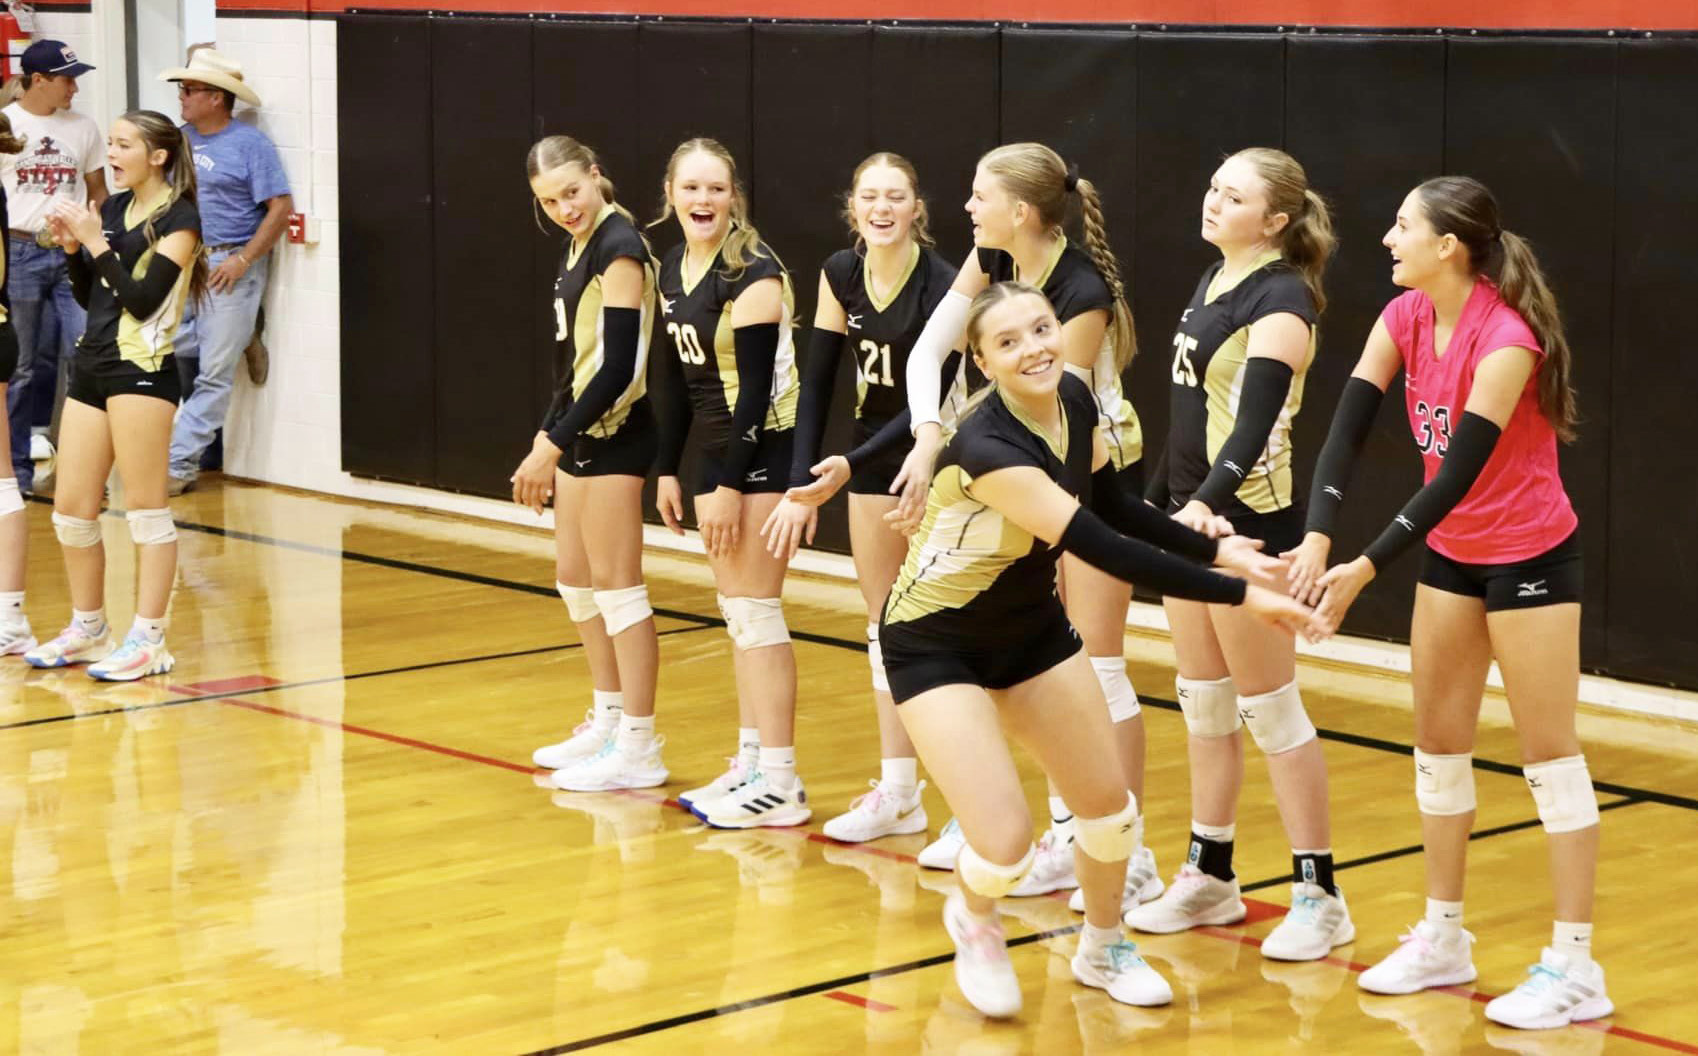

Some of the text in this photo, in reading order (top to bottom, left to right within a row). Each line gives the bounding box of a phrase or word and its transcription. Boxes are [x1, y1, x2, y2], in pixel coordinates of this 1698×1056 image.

[16, 167, 77, 185] STATE
[666, 321, 706, 365] 20
[859, 339, 894, 387] 21
[1172, 332, 1199, 388] 25
[1415, 400, 1453, 458] 33
